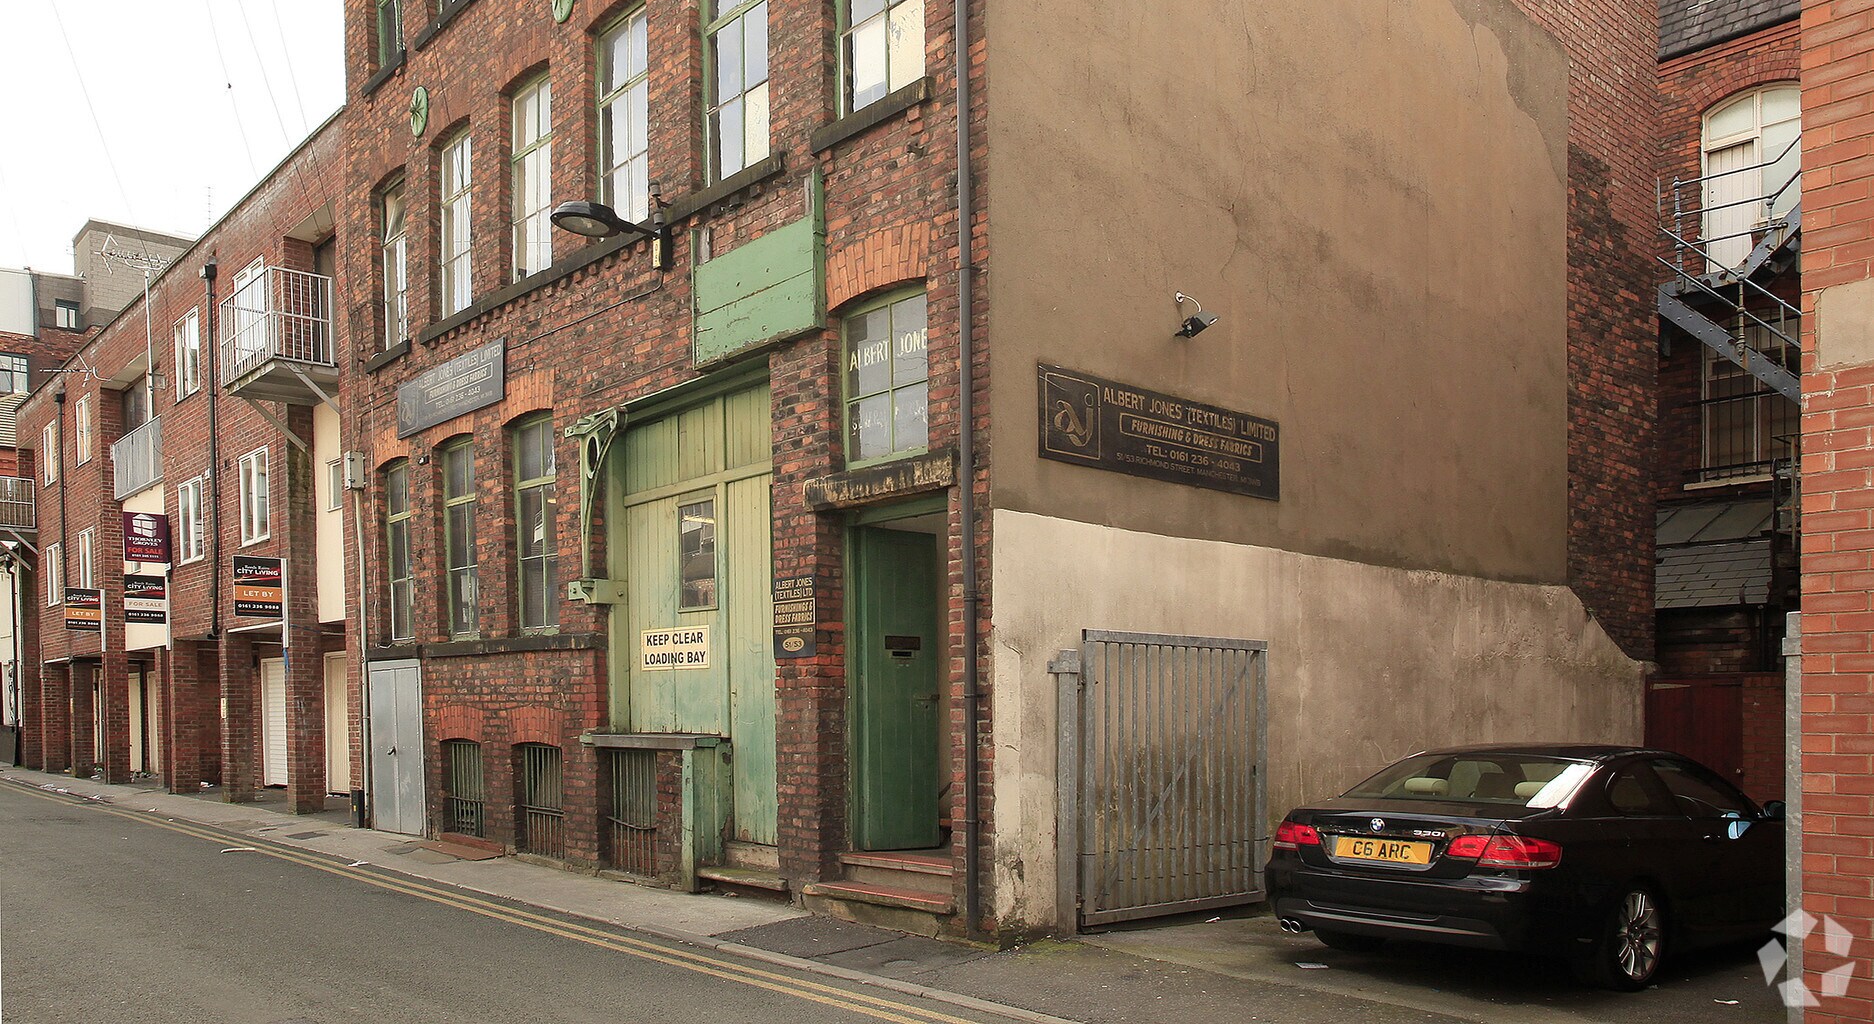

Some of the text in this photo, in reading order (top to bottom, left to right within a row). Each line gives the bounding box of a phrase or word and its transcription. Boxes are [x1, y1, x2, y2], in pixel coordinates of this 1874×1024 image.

[480, 344, 502, 362] LIMITED
[849, 340, 890, 372] ALBERT
[1103, 386, 1276, 442] ALBERT JONES (TEXTILES) LIMITED
[1131, 419, 1253, 456] FURNISHING & DRESS FABRICS
[1135, 456, 1170, 470] RICHMOND
[1146, 444, 1168, 458] TEL:
[1169, 449, 1189, 462] 0161
[1191, 454, 1209, 466] 236
[1217, 459, 1241, 472] 4043
[775, 577, 813, 589] ALBERT JONES
[775, 588, 813, 601] (TEXTILES) LTD
[775, 611, 813, 624] DRESS FABRICS
[646, 631, 703, 646] KEEP CLEAR
[645, 651, 706, 665] LOADING BAY
[1352, 841, 1411, 859] C6 ARC
